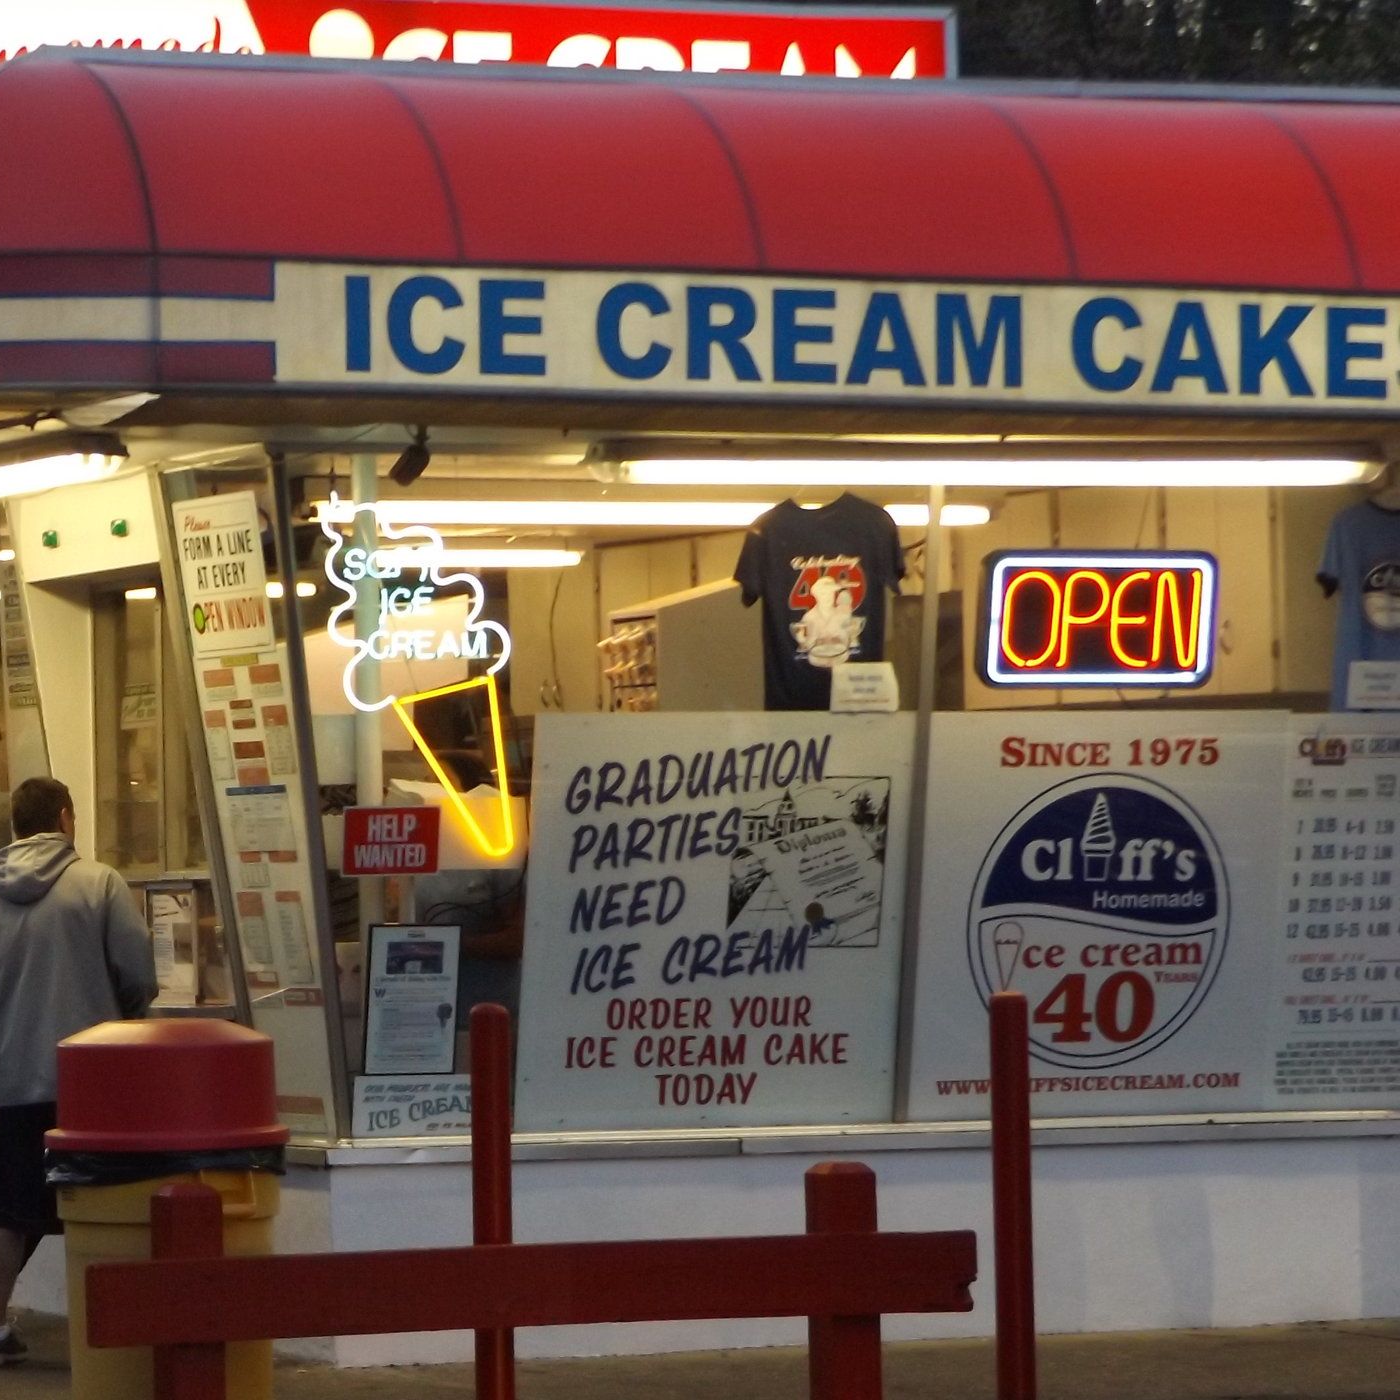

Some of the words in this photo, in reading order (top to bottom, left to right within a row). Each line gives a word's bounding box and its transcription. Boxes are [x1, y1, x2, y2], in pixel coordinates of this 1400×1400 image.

[345, 275, 545, 376] ICE
[596, 282, 1022, 387] CREAM
[1072, 297, 1400, 399] CAKE
[183, 534, 212, 561] FORM
[216, 538, 225, 557] A
[226, 529, 254, 556] LINE
[197, 565, 208, 590] AT
[212, 561, 247, 588] EVERY
[225, 597, 267, 629] WINDOW
[380, 586, 435, 617] ICE
[1002, 570, 1202, 667] OPEN
[367, 630, 489, 659] CREAM
[1127, 738, 1220, 767] 1975
[566, 734, 831, 814] GRADUATION
[367, 814, 417, 842] HELP
[568, 807, 742, 874] PARTIES
[354, 844, 426, 868] WANTED
[569, 876, 685, 934] NEED
[1092, 890, 1205, 909] Homemade
[570, 942, 641, 995] ICE
[662, 924, 810, 986] CREAM
[1080, 941, 1203, 968] cream
[607, 997, 712, 1030] ORDER
[730, 995, 812, 1028] YOUR
[1033, 970, 1156, 1043] 40
[565, 1036, 618, 1069] ICE
[634, 1034, 747, 1068] CREAM
[764, 1033, 849, 1065] CAKE
[655, 1072, 757, 1105] TODAY
[937, 1072, 1240, 1095] WWWIFFSICECREAM.COM
[367, 1109, 402, 1131] ICE
